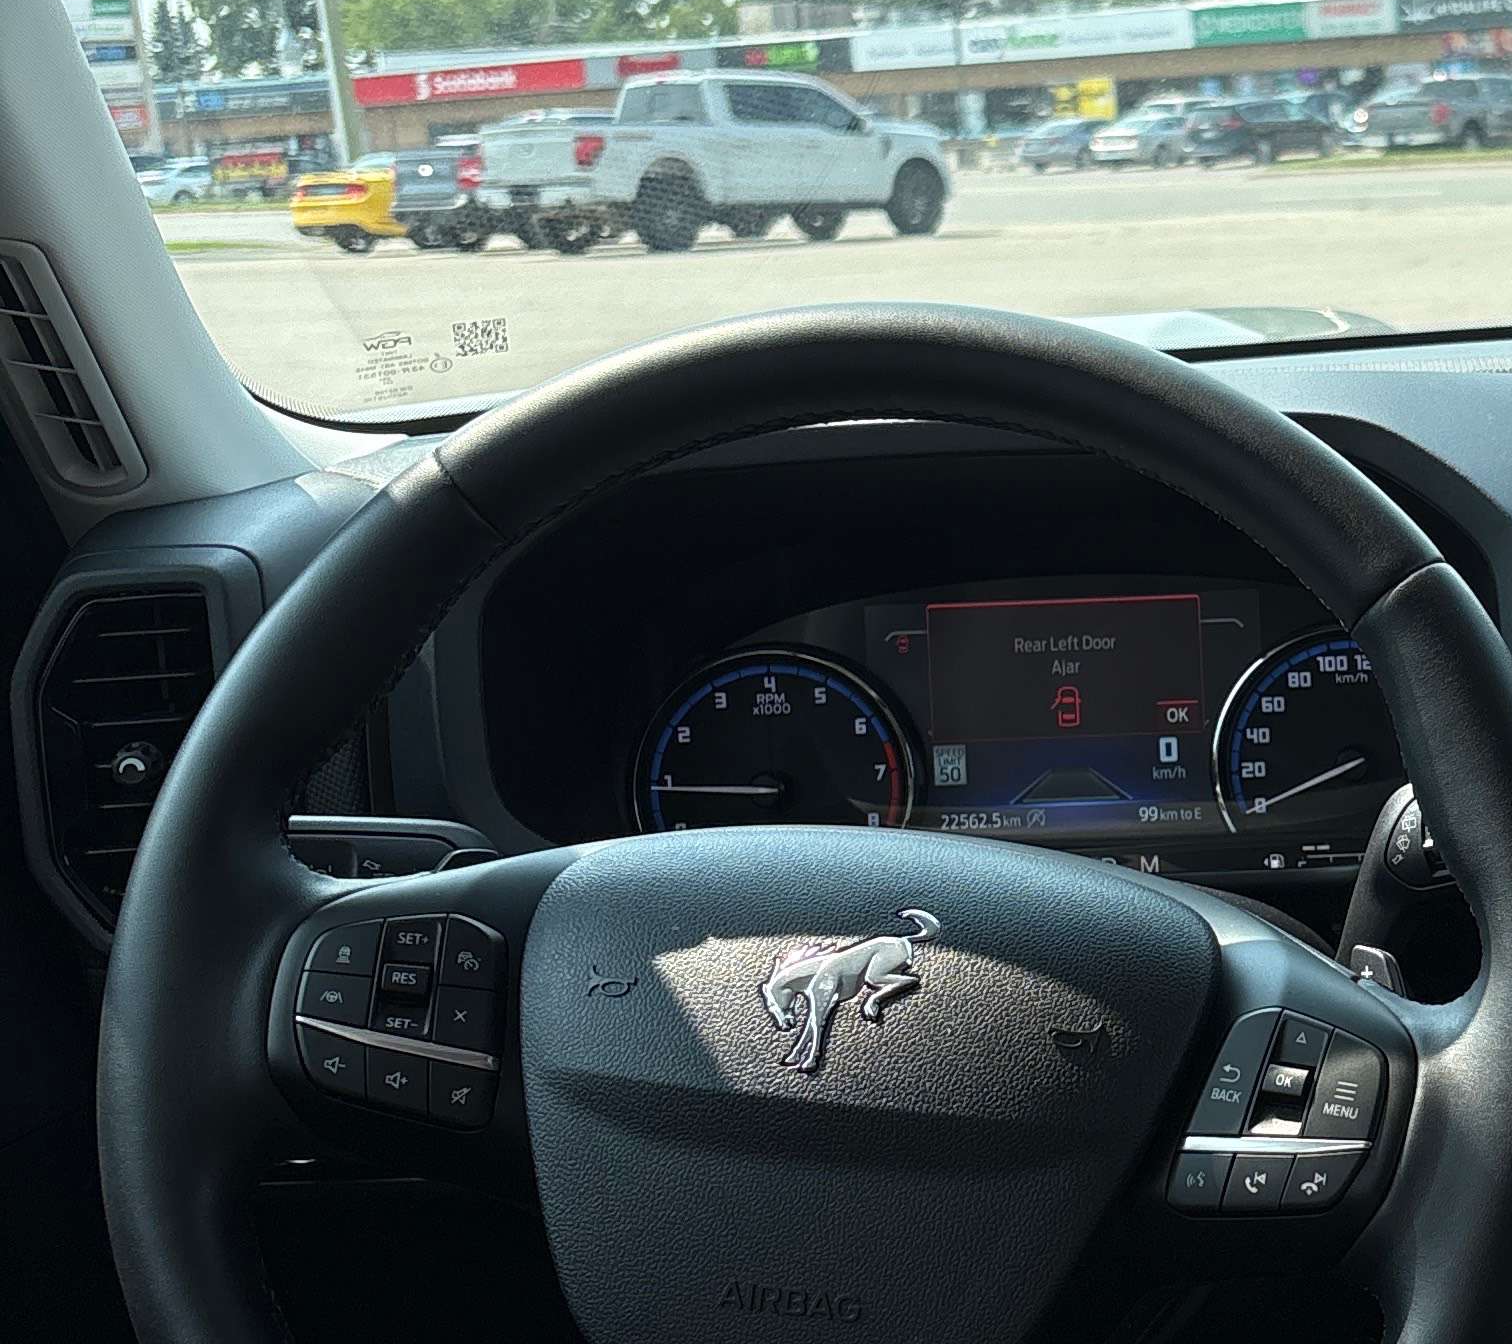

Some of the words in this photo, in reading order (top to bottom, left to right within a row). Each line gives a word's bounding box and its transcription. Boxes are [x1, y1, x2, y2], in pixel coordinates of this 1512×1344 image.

[1014, 638, 1047, 654] Rear
[1050, 636, 1080, 652] Left
[1082, 635, 1117, 650] Door
[1051, 659, 1081, 676] Ajar
[1316, 655, 1348, 672] 100
[763, 675, 776, 693] 4
[1287, 671, 1312, 688] 80
[1335, 672, 1369, 684] km/h
[715, 692, 727, 709] 3
[756, 693, 785, 705] RPM
[814, 687, 826, 704] 5
[752, 702, 791, 716] x1000
[1261, 696, 1285, 713] 60
[1166, 706, 1190, 723] OK
[678, 726, 690, 743] 2
[854, 717, 867, 735] 6
[1245, 727, 1270, 744] 40
[874, 764, 886, 781] 7
[940, 767, 961, 783] 50
[1152, 766, 1187, 781] km/h
[1241, 761, 1266, 777] 20
[940, 811, 1001, 831] 22562.5
[1002, 814, 1021, 828] km
[1139, 806, 1159, 823] 99
[1160, 808, 1178, 821] km
[1180, 808, 1193, 821] to
[1140, 855, 1159, 873] M
[397, 931, 430, 946] SET+
[391, 971, 417, 985] RES
[385, 1017, 419, 1029] SET-
[1275, 1073, 1294, 1088] OK
[1210, 1087, 1241, 1104] BACK
[1322, 1102, 1358, 1120] MENU
[721, 1280, 862, 1324] AIRBAG
